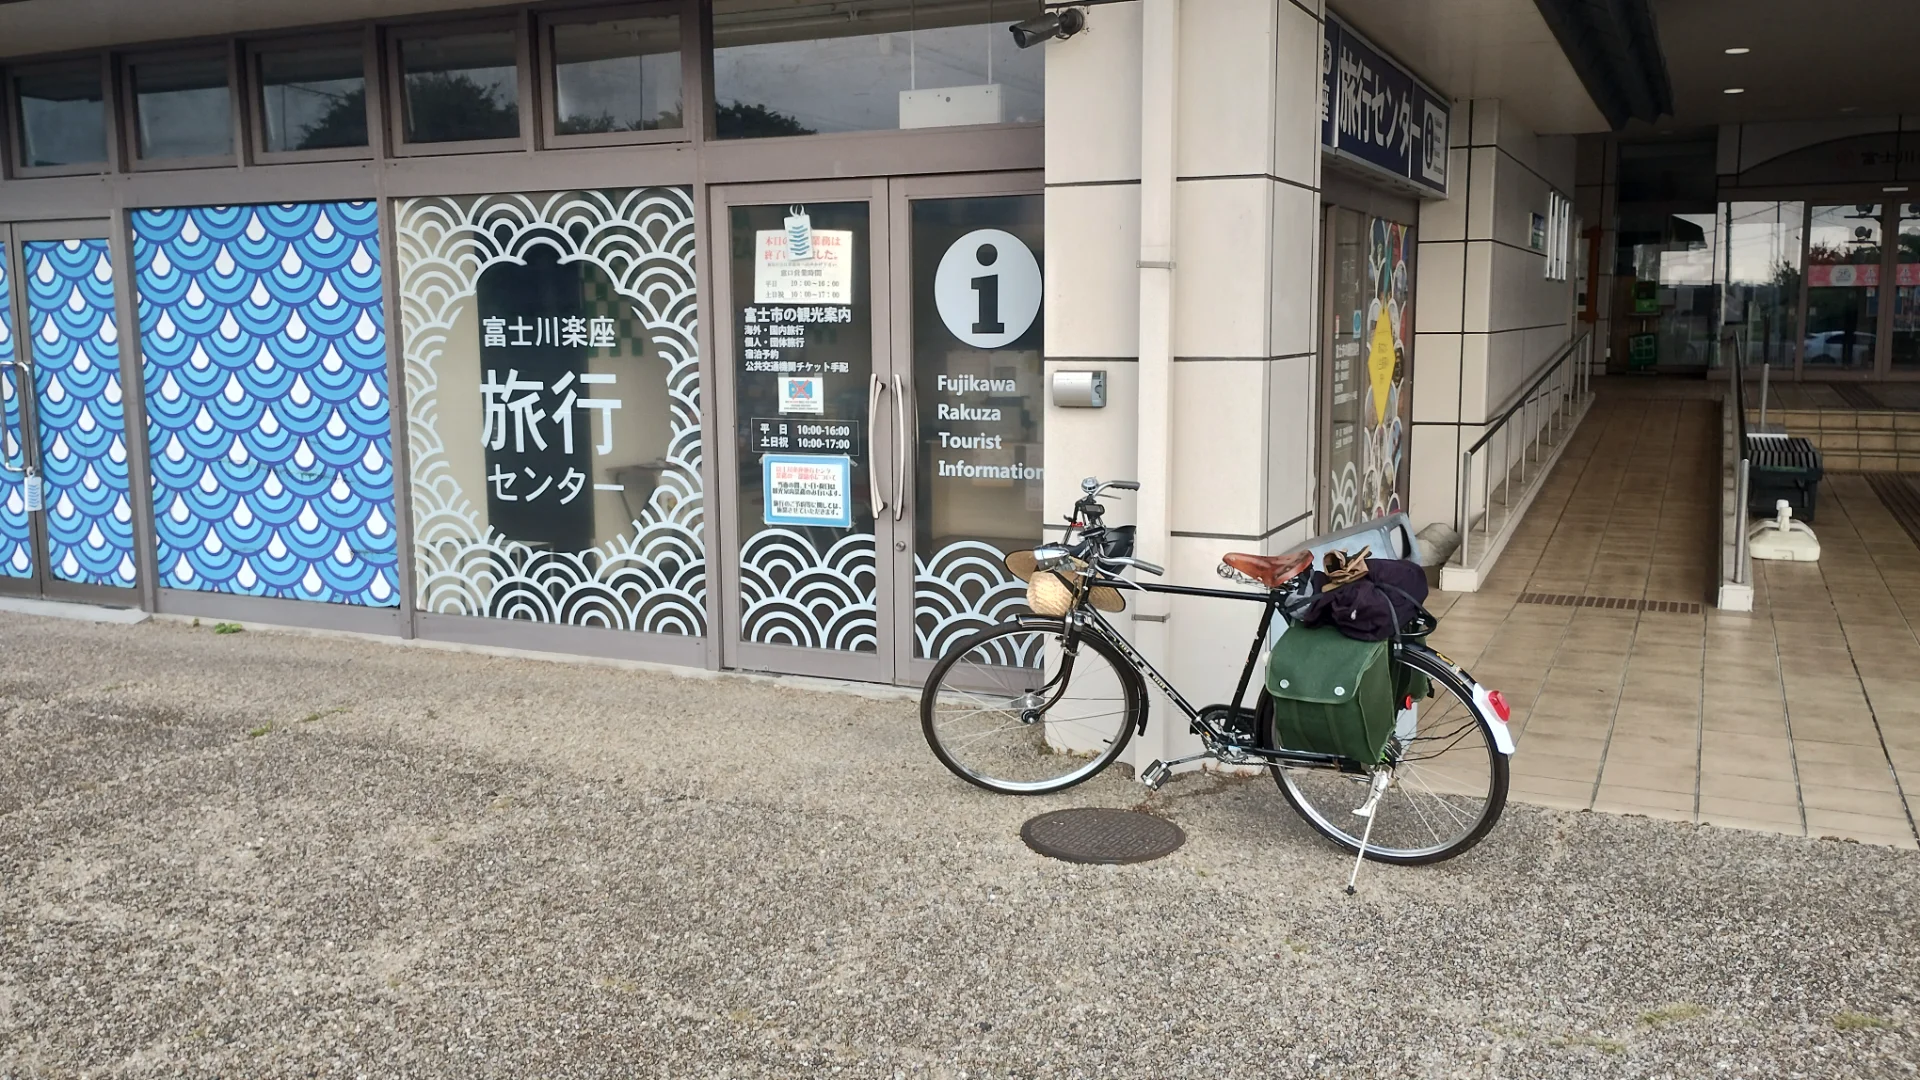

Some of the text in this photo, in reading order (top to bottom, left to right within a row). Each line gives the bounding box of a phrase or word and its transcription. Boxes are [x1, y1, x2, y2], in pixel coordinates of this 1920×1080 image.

[1339, 45, 1420, 157] 旅行センター
[743, 306, 852, 323] 富士市の観光案内
[482, 315, 617, 348] 富士川楽座
[744, 324, 805, 336] 海外・国内旅行
[744, 348, 780, 360] 宿泊予約
[937, 374, 1017, 396] Fujikawa
[479, 368, 623, 456] 旅行
[937, 403, 1002, 421] Rakuza
[796, 424, 850, 437] 10:00-16:00
[760, 436, 851, 450] 土日祝 10:00-17:00
[938, 432, 1003, 450] Tourist
[938, 459, 1044, 480] Information
[488, 463, 625, 505] センター
